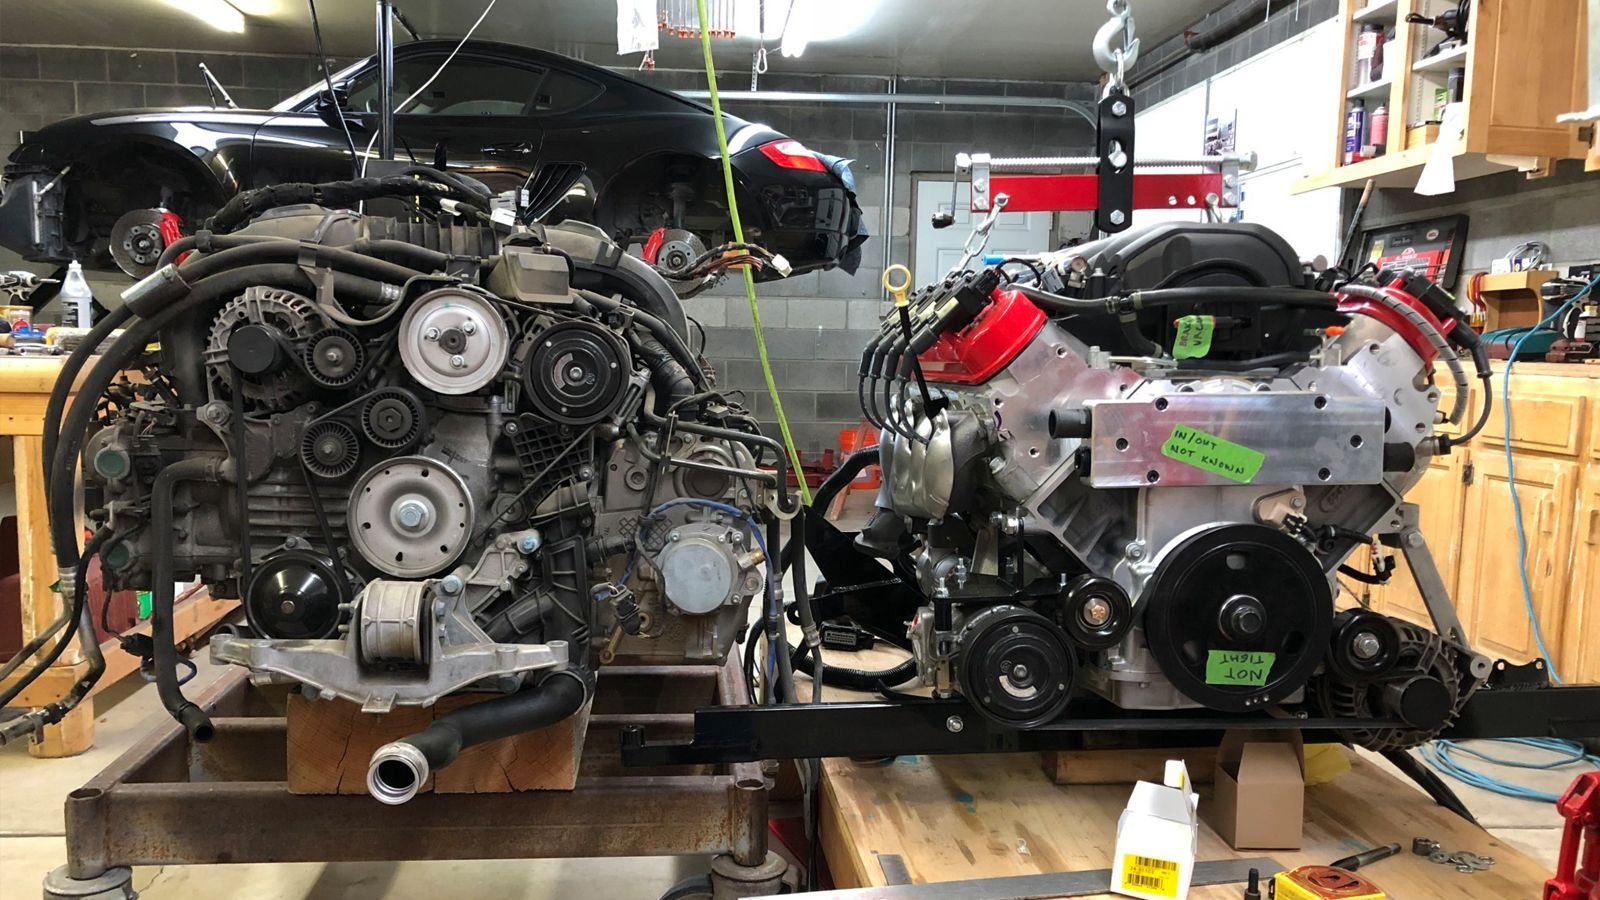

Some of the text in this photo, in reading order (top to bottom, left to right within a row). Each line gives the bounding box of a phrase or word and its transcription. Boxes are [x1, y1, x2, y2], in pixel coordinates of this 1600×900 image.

[1174, 430, 1217, 450] IN/OUT
[1170, 444, 1245, 475] NOT KNOWN
[1219, 653, 1264, 665] TIGHT
[1224, 667, 1263, 681] NOT
